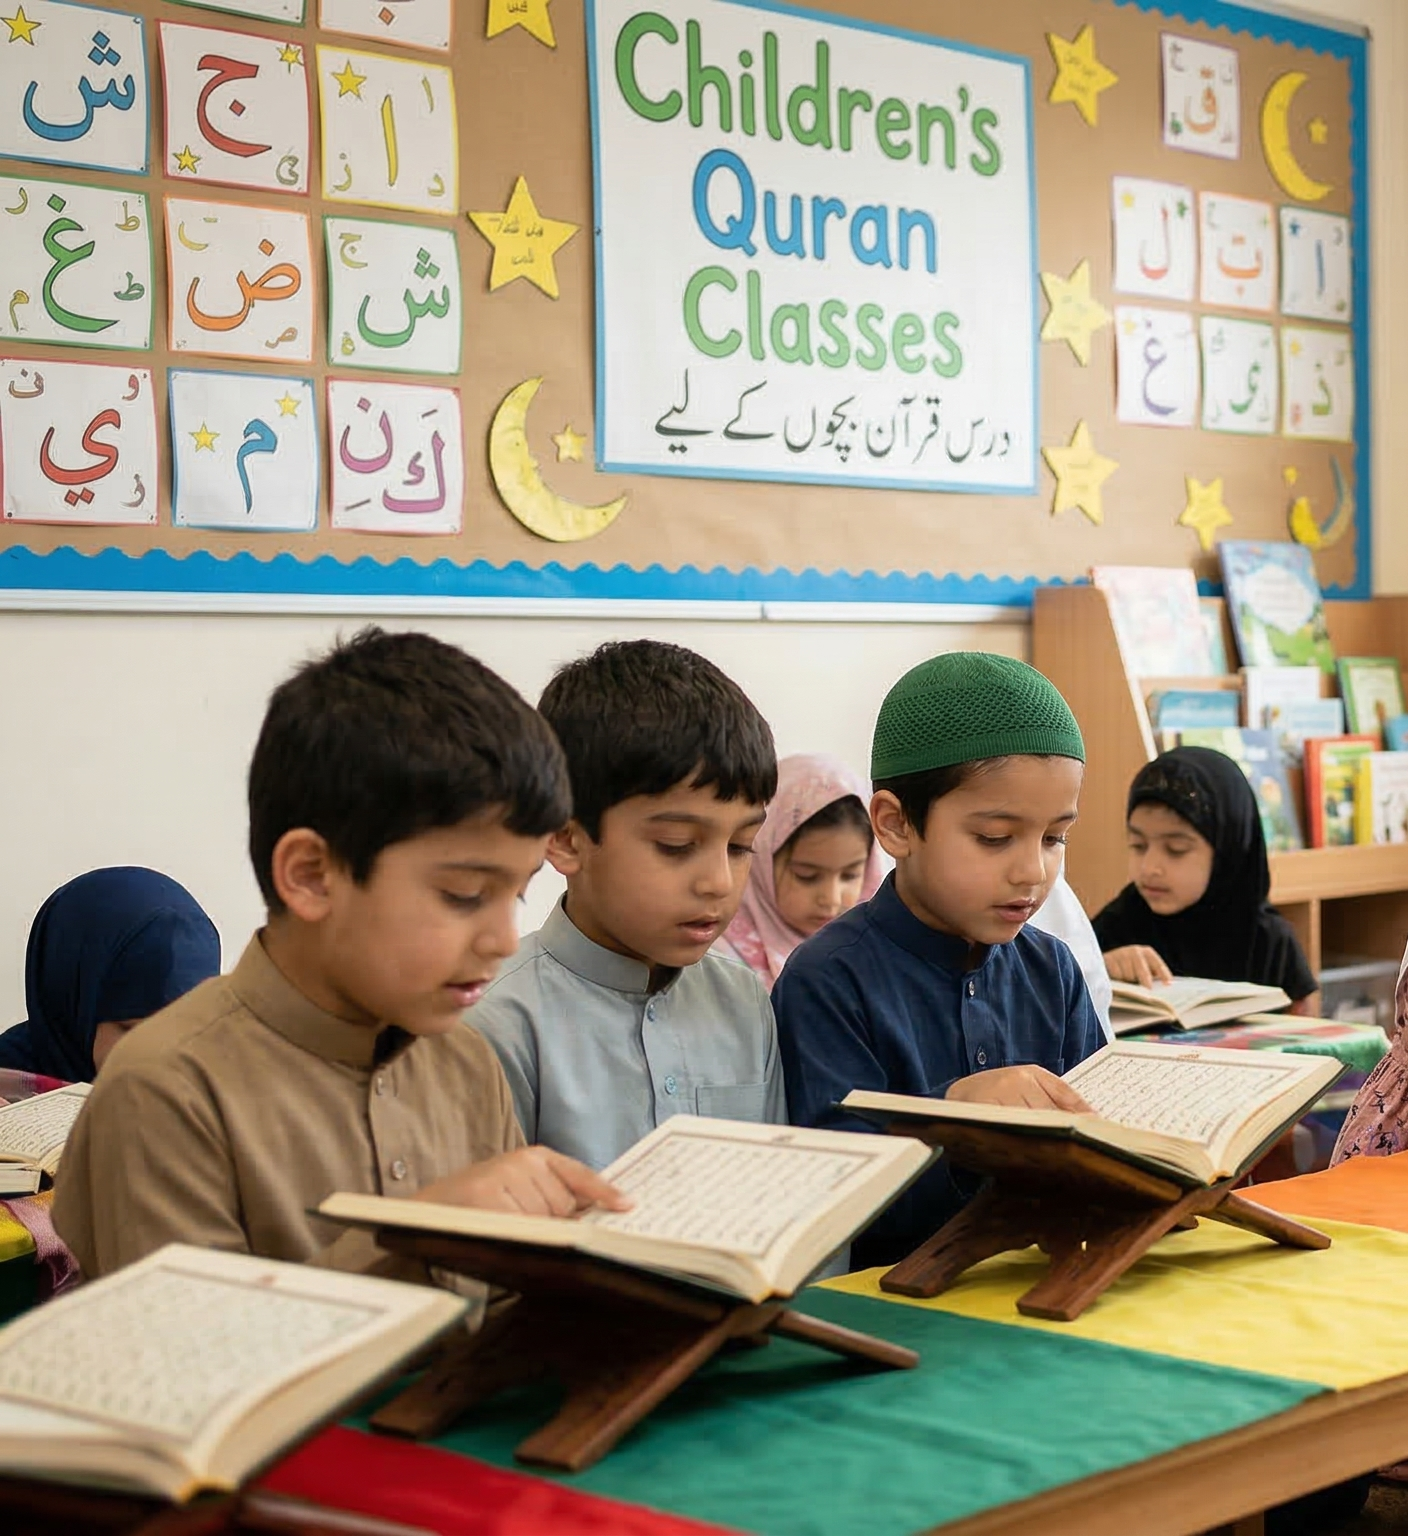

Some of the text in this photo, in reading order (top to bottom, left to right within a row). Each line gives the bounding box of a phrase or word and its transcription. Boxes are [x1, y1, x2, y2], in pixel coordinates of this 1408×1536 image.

[23, 30, 136, 142] ش
[197, 54, 272, 158] ج
[614, 11, 1001, 177] Children's
[692, 148, 938, 274] Quran
[42, 193, 120, 334] غ
[186, 238, 302, 332] ض
[357, 247, 450, 349] ش
[683, 264, 964, 379] Classes
[40, 408, 121, 507] ي
[722, 380, 774, 440] کے
[783, 395, 858, 463] بچوں
[865, 395, 941, 465] قرآن
[945, 416, 1011, 463] درس
[236, 418, 278, 514] م
